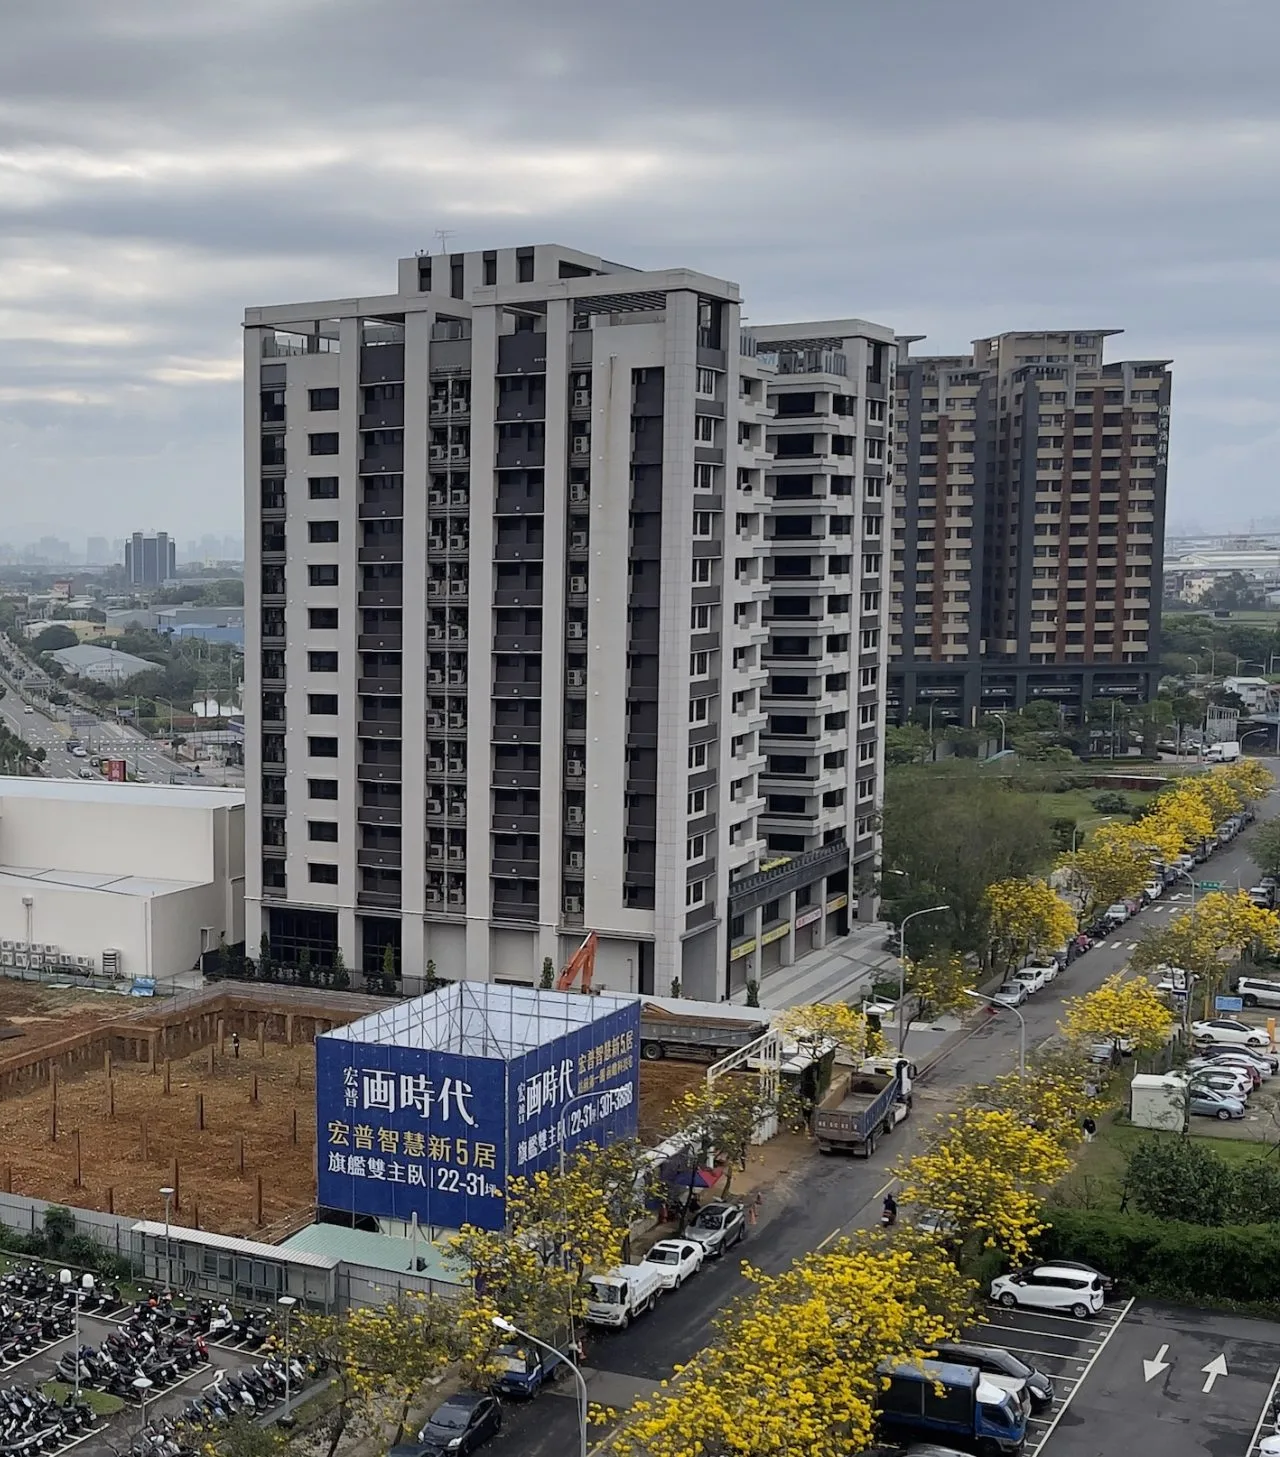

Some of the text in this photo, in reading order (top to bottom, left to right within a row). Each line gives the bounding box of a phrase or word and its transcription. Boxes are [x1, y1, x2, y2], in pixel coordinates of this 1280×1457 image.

[343, 1066, 359, 1108] 宏普
[327, 1119, 497, 1170] 宏普智慧新5居
